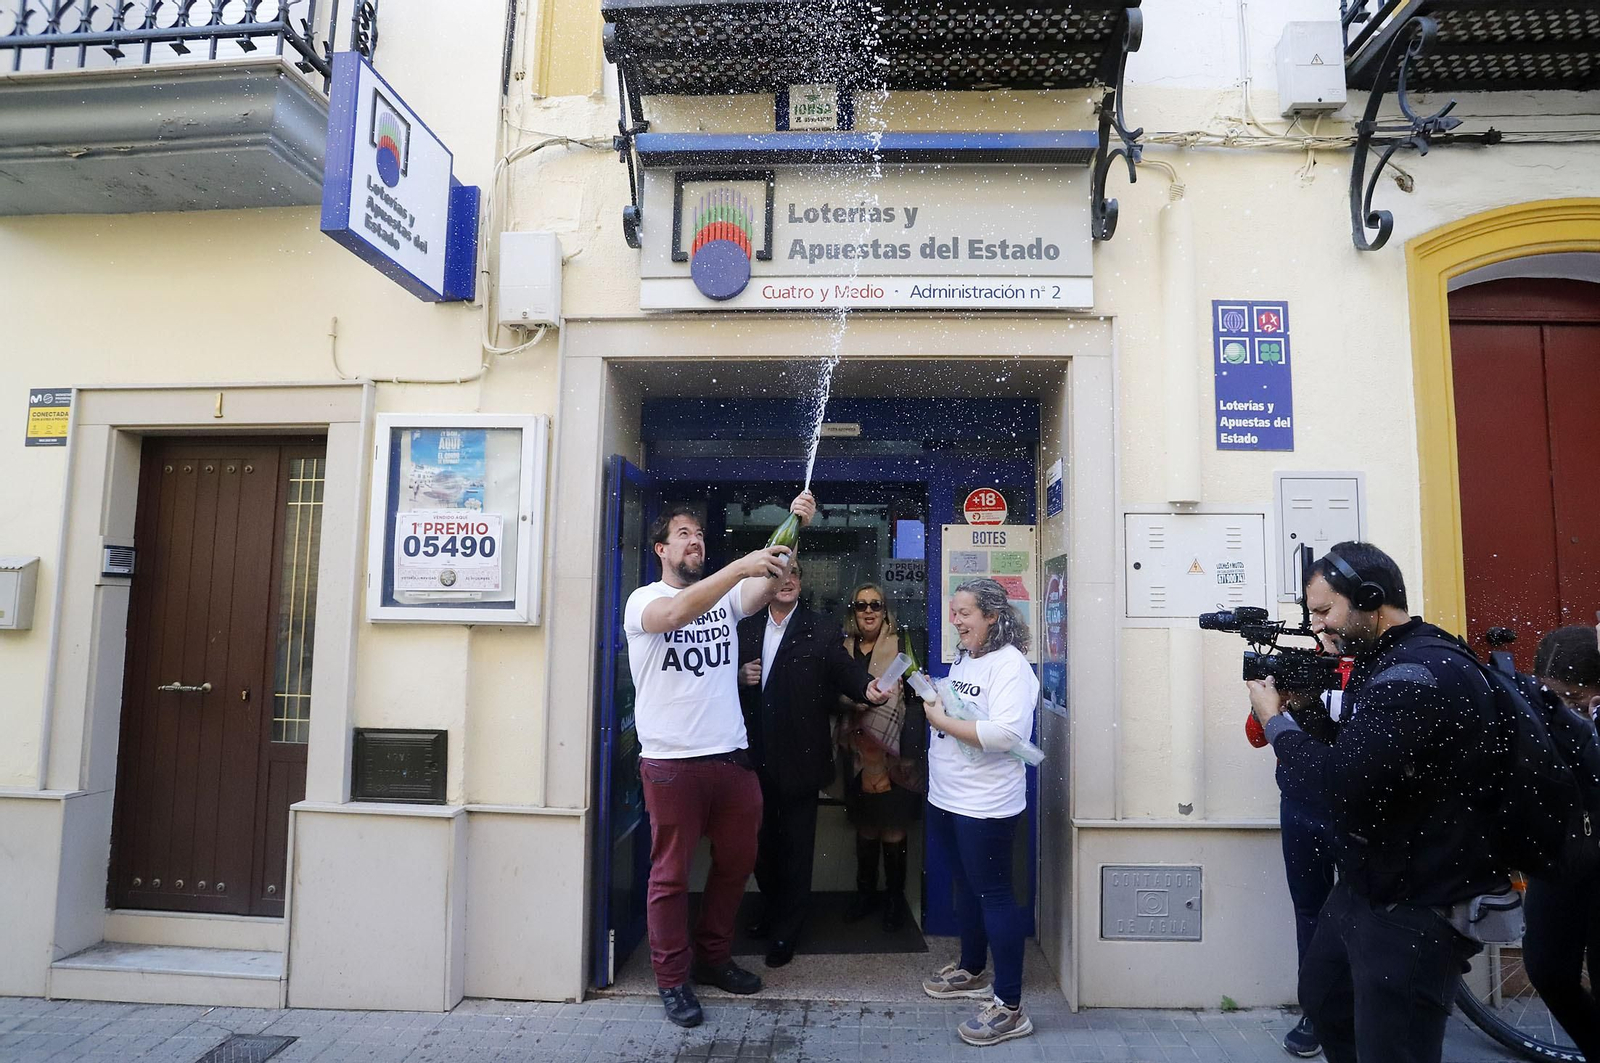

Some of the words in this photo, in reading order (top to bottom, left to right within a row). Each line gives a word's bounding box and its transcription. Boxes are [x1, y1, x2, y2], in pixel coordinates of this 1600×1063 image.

[366, 174, 408, 219] Loterías
[408, 213, 416, 229] y
[788, 203, 896, 223] Loterías
[903, 206, 918, 229] y
[364, 212, 400, 251] Estado
[365, 195, 412, 242] Apuestas
[413, 234, 428, 255] del
[788, 238, 911, 265] Apuestas
[919, 236, 959, 260] del
[968, 237, 1060, 261] Estado
[762, 284, 815, 300] Cuatro
[820, 288, 829, 302] y
[834, 284, 884, 299] Medio
[909, 283, 1025, 299] Administración
[1052, 285, 1061, 299] 2
[1219, 400, 1265, 411] Loterías
[1267, 402, 1275, 414] y
[1220, 416, 1271, 429] Apuestas
[1273, 417, 1291, 428] del
[1220, 433, 1259, 444] Estado
[972, 492, 997, 506] +18
[423, 522, 489, 535] PREMIO
[403, 535, 496, 558] 05490
[972, 531, 1006, 545] BOTES
[895, 562, 926, 570] PREMI
[885, 569, 925, 582] 0549
[689, 607, 727, 626] EMIO
[663, 624, 730, 644] VENDIDO
[661, 638, 731, 677] AQUÍ
[1112, 872, 1194, 888] CONTADOR
[1117, 919, 1136, 934] DE
[1149, 919, 1189, 934] AGUA
